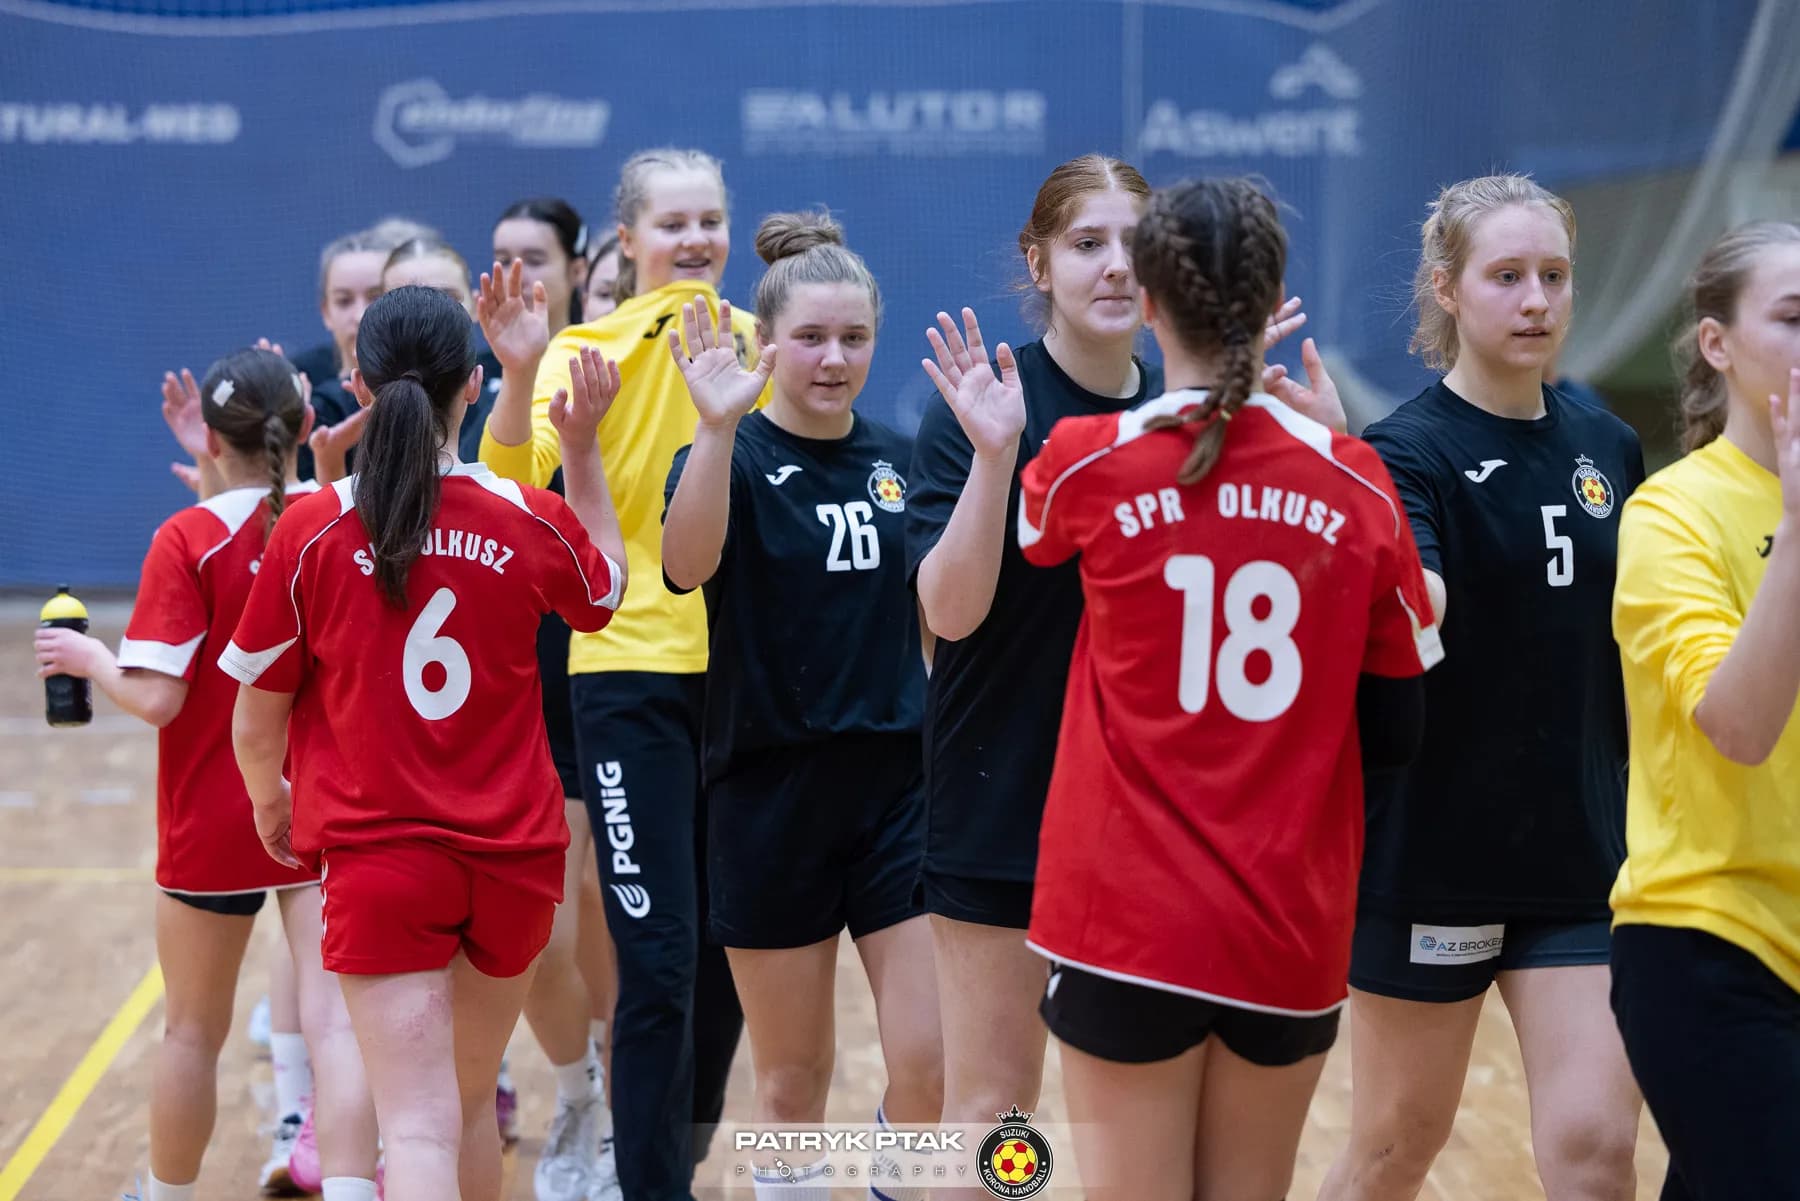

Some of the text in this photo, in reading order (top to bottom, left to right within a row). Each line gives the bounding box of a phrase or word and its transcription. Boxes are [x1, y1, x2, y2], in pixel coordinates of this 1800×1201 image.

[816, 501, 880, 571] 26
[1114, 482, 1346, 545] SPR OLKUSZ
[1540, 504, 1574, 586] 5
[402, 587, 471, 721] 6
[1163, 554, 1303, 722] 18
[596, 761, 641, 875] PGNiG
[1437, 941, 1456, 952] AZ
